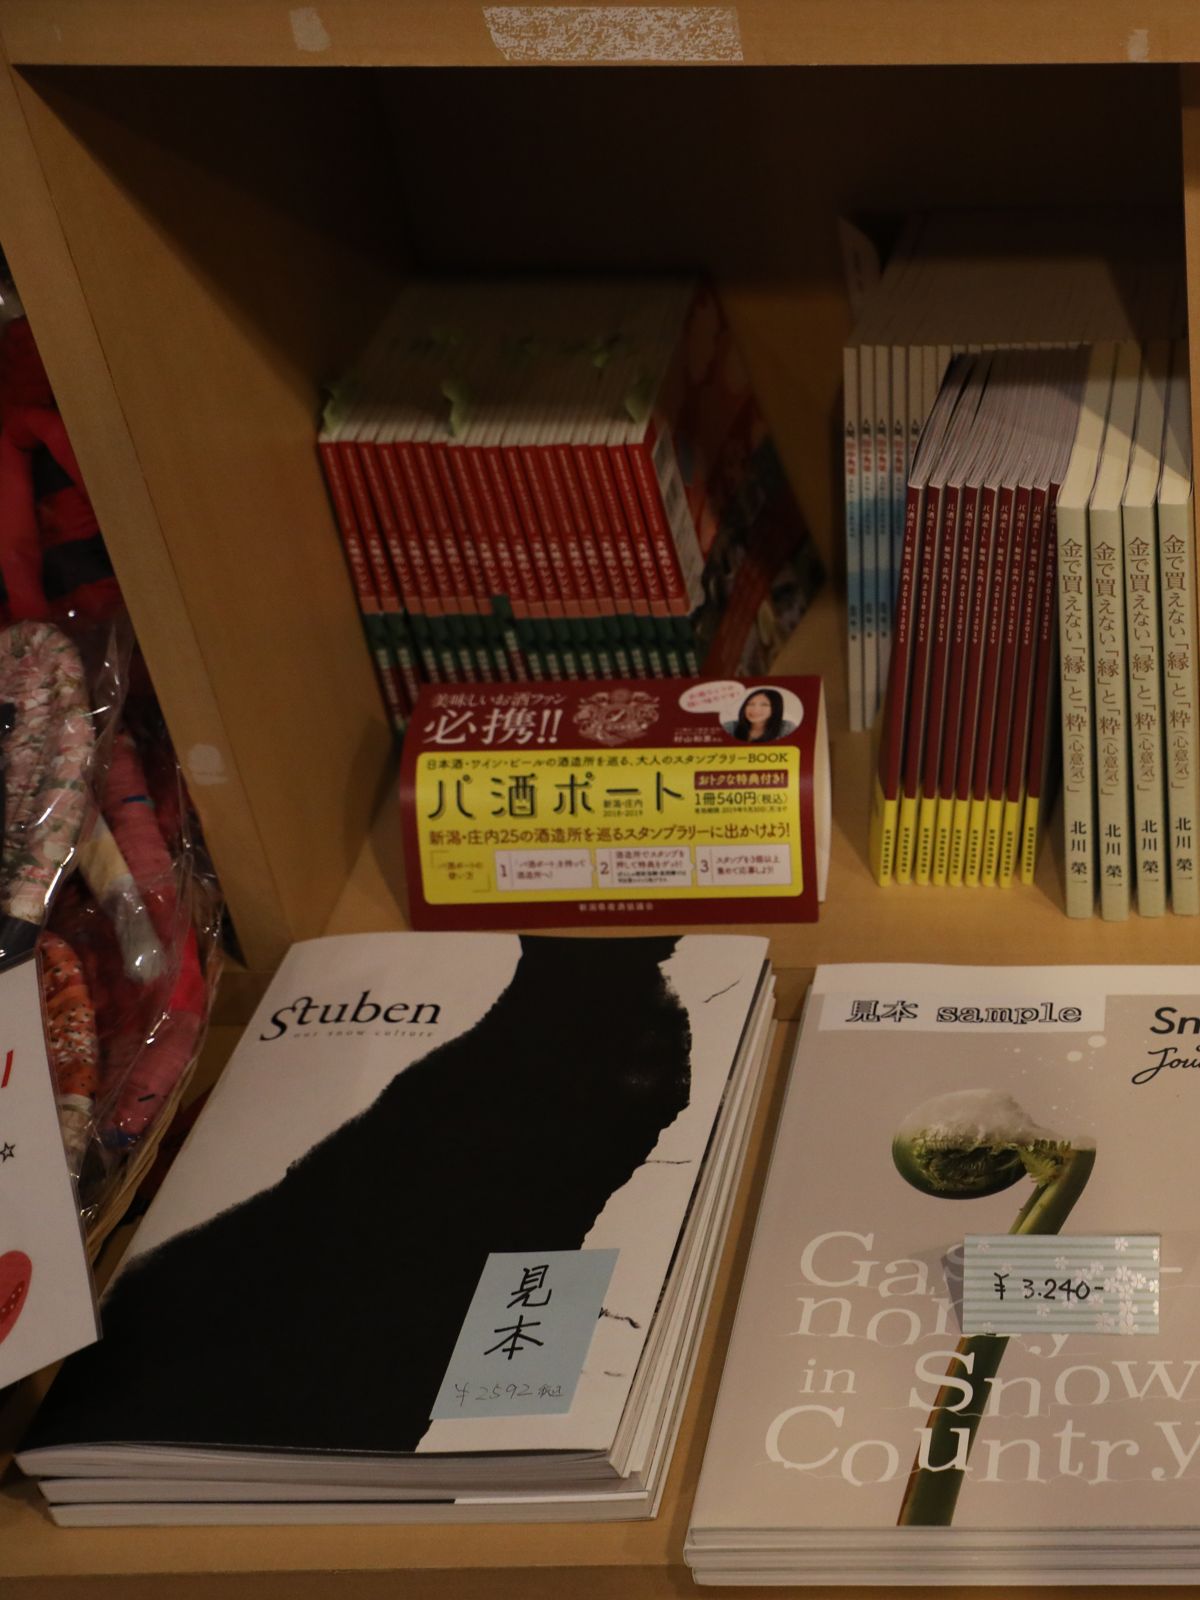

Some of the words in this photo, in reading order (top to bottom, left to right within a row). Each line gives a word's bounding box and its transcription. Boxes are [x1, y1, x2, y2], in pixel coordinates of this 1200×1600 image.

[427, 771, 683, 820] パ酒ポート
[600, 863, 610, 876] 2
[699, 860, 709, 873] 3
[260, 990, 441, 1041] Stuben
[846, 1000, 920, 1023] 見本
[936, 1000, 1083, 1025] sample
[327, 1029, 366, 1038] snow
[483, 1264, 553, 1361] 見本
[798, 1358, 858, 1394] in
